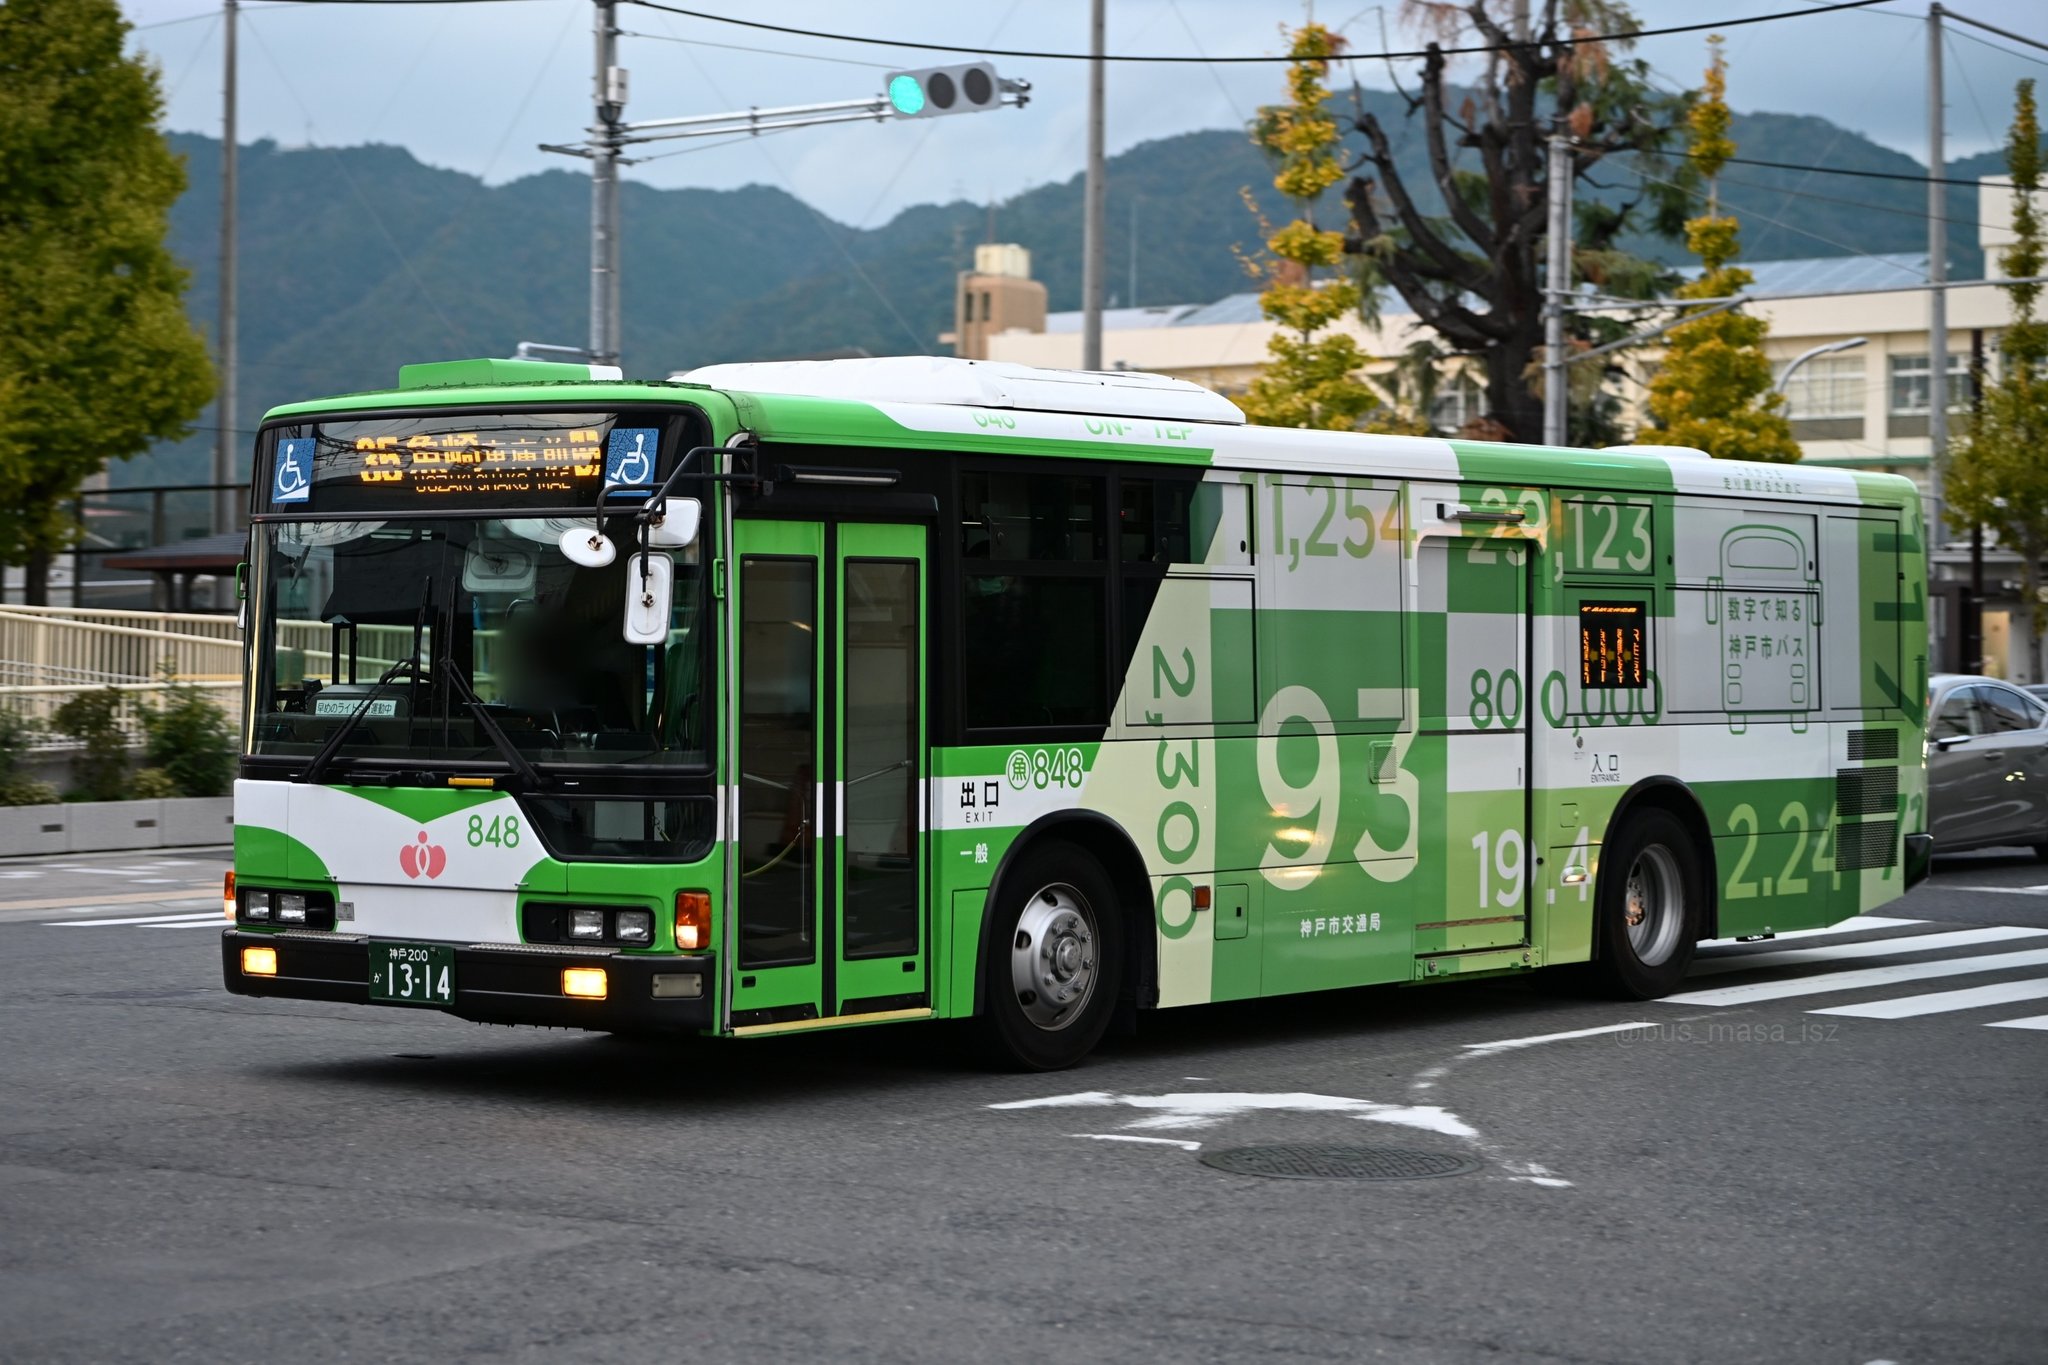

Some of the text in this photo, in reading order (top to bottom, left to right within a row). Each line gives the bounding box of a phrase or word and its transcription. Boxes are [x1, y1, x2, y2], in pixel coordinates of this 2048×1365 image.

[1238, 472, 1418, 573] 11,254
[1728, 596, 1801, 621] 数字で知る
[1729, 634, 1804, 659] 神戸市バス
[1033, 749, 1084, 789] 848
[1592, 754, 1618, 772] 入口
[1256, 685, 1420, 891] 93
[1591, 773, 1620, 783] ENTRANCE
[960, 781, 1000, 808] 出口
[966, 811, 993, 823] EXIT
[467, 814, 520, 848] 848
[960, 843, 988, 863] 一般
[1300, 913, 1381, 938] 神戸市交通局
[373, 962, 450, 1000] か 13-14
